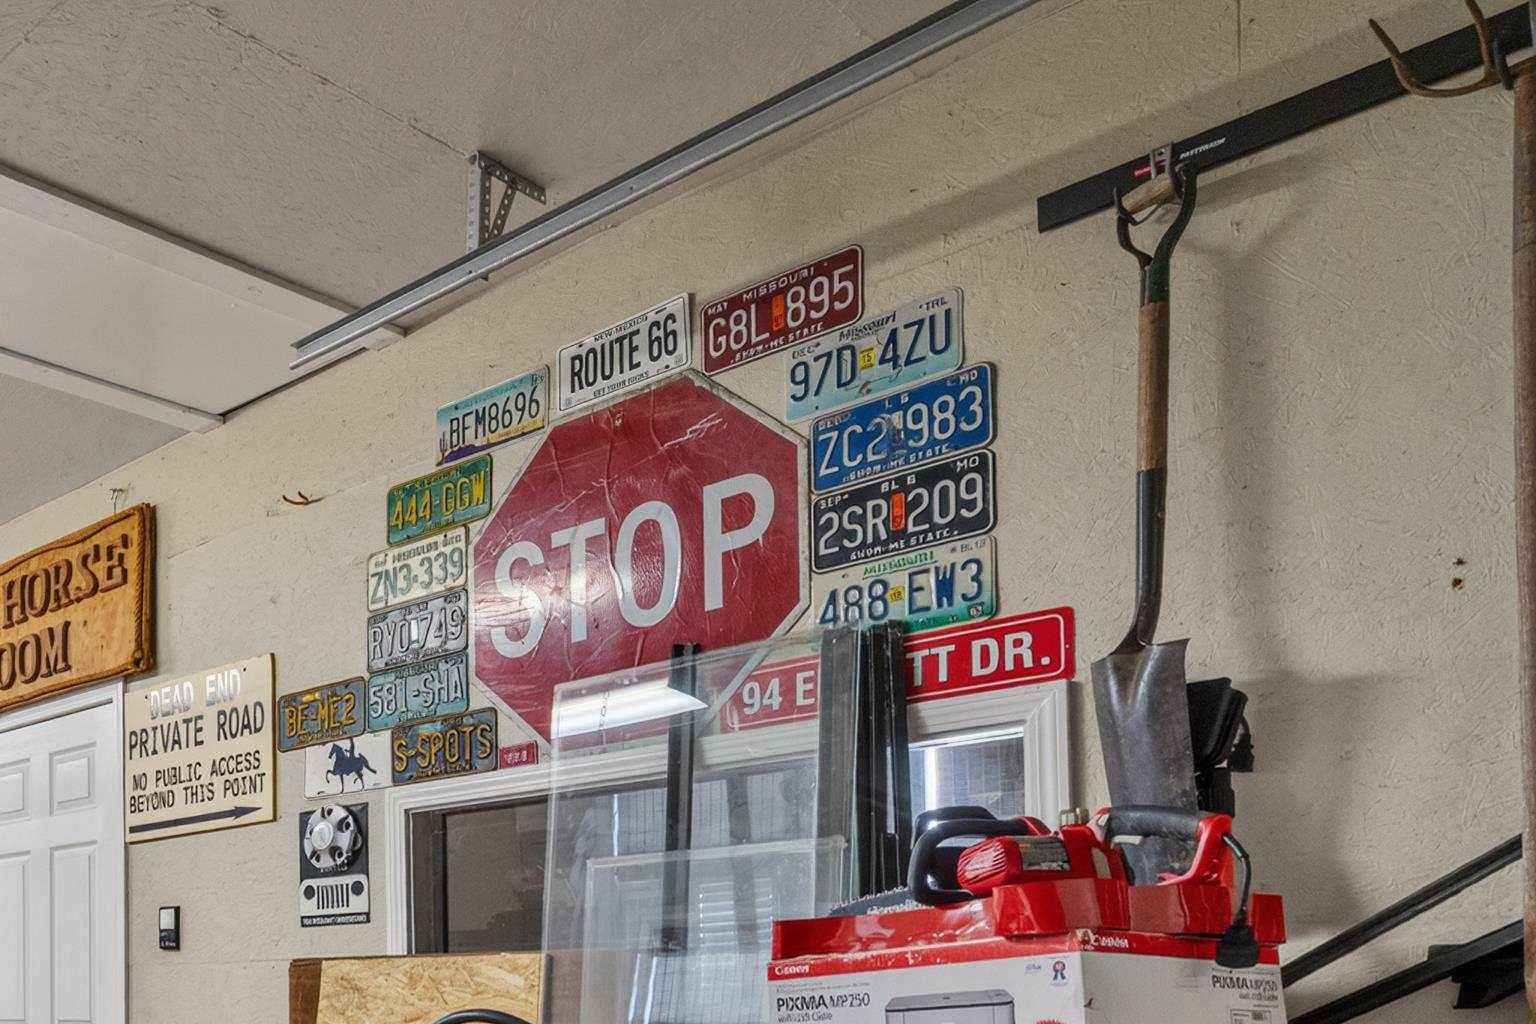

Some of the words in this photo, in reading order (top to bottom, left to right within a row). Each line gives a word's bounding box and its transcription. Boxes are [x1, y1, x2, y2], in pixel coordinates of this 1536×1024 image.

[709, 303, 769, 357] G8L
[786, 264, 854, 328] 895
[743, 267, 815, 301] MISSOURI
[570, 328, 641, 394] ROUTE
[648, 313, 678, 362] 66
[790, 344, 857, 402] 97D
[878, 308, 951, 370] 4ZU
[449, 385, 540, 449] BFM8696
[906, 386, 983, 447] 983
[956, 455, 980, 472] MO
[818, 498, 888, 556] 2SR
[907, 472, 984, 534] 209
[2, 532, 131, 631] HORSE
[493, 473, 776, 661] STOP
[819, 578, 890, 627] 488
[906, 557, 984, 617] EW3
[148, 681, 194, 720] DEAD
[205, 669, 242, 708] END
[742, 676, 783, 717] 94
[971, 631, 1051, 677] DR.
[128, 714, 204, 760] PRIVATE
[216, 701, 265, 742] ROAD
[129, 786, 175, 814] BEYOND
[183, 779, 216, 803] THIS
[222, 773, 267, 798] POINT
[132, 772, 148, 792] NO
[154, 762, 203, 787] PUBLIC
[209, 750, 262, 780] ACCESS
[774, 964, 810, 976] Canon
[1211, 974, 1249, 990] PIXMA
[777, 994, 828, 1012] PIXMA
